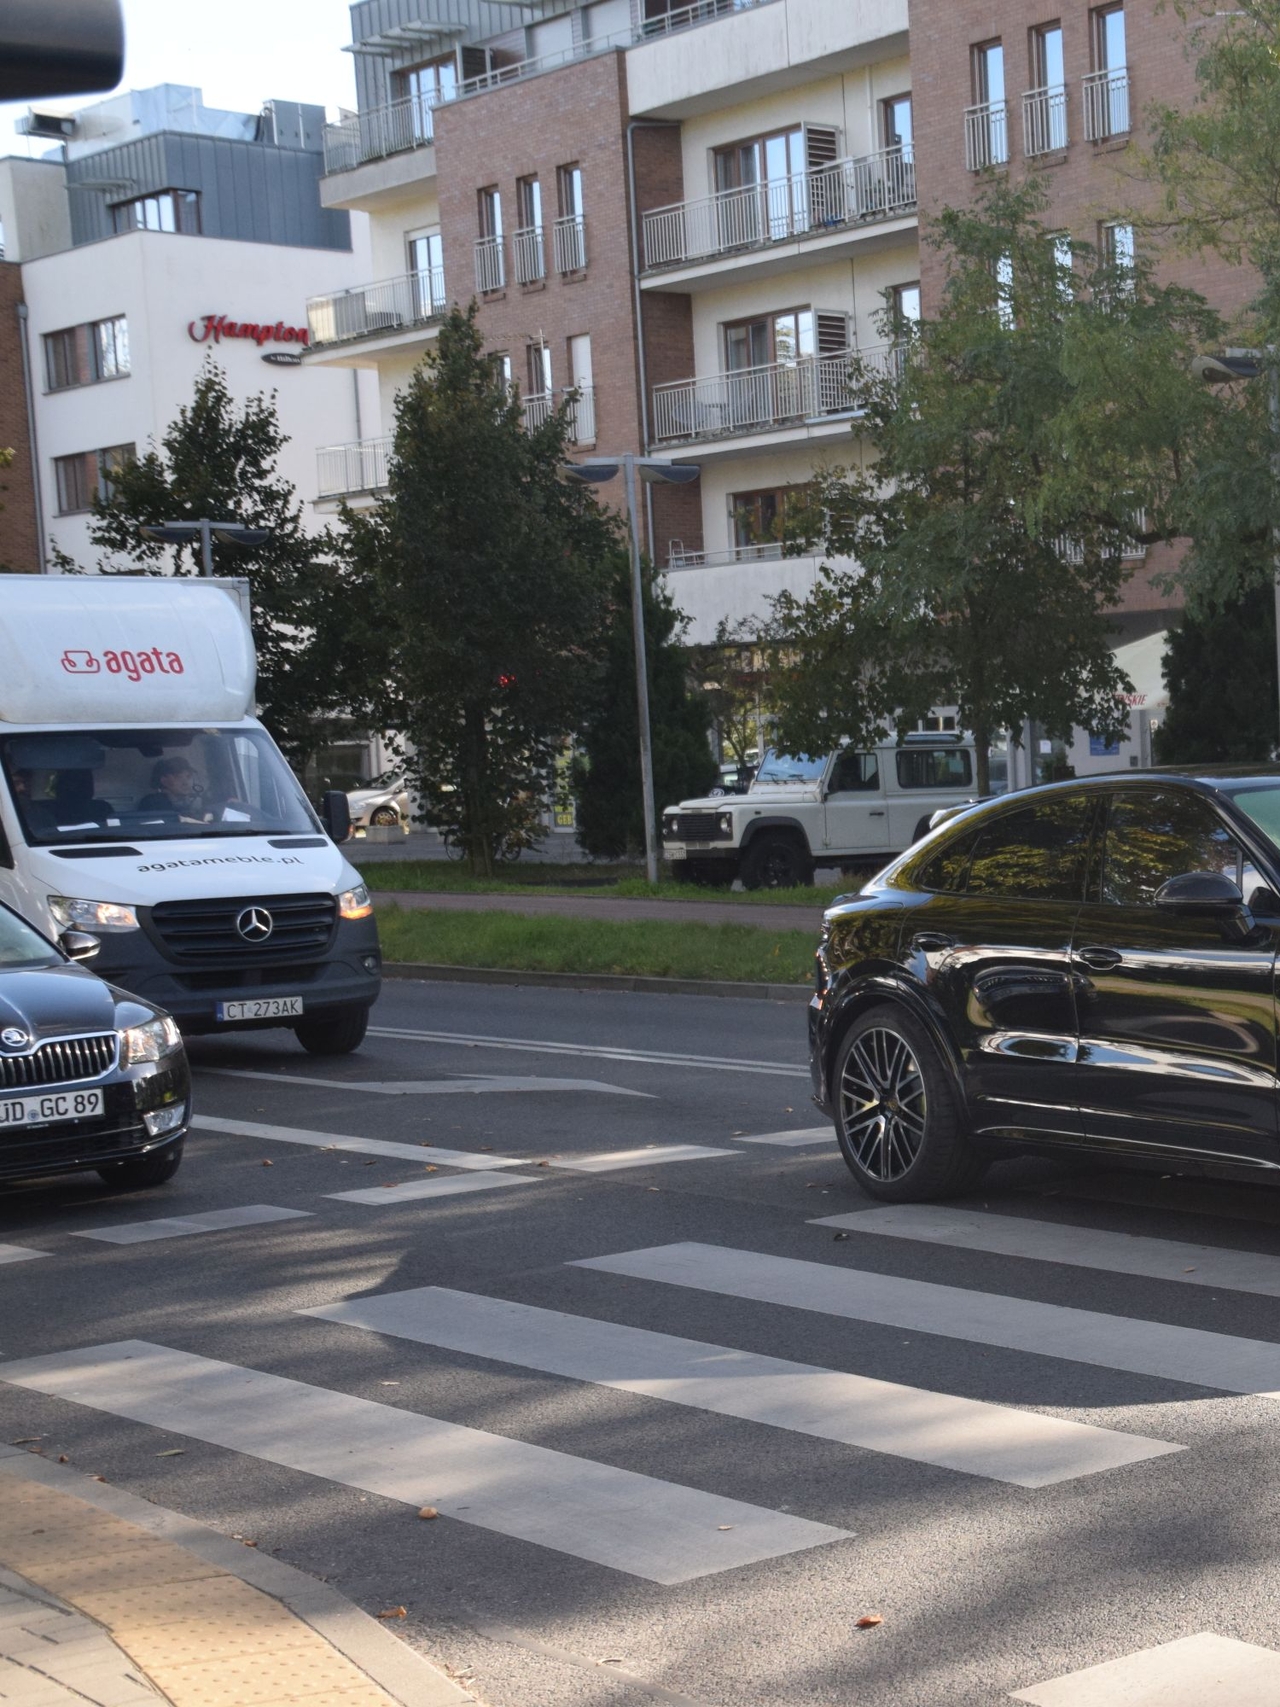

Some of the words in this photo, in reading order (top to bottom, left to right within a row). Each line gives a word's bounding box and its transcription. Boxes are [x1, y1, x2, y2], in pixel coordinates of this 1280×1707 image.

[187, 314, 309, 346] Hampton
[103, 647, 184, 682] agata
[137, 855, 305, 873] agatameble.pl
[227, 1003, 247, 1018] CT
[254, 999, 299, 1017] 273AK
[40, 1096, 69, 1118] GC
[74, 1092, 99, 1114] 89
